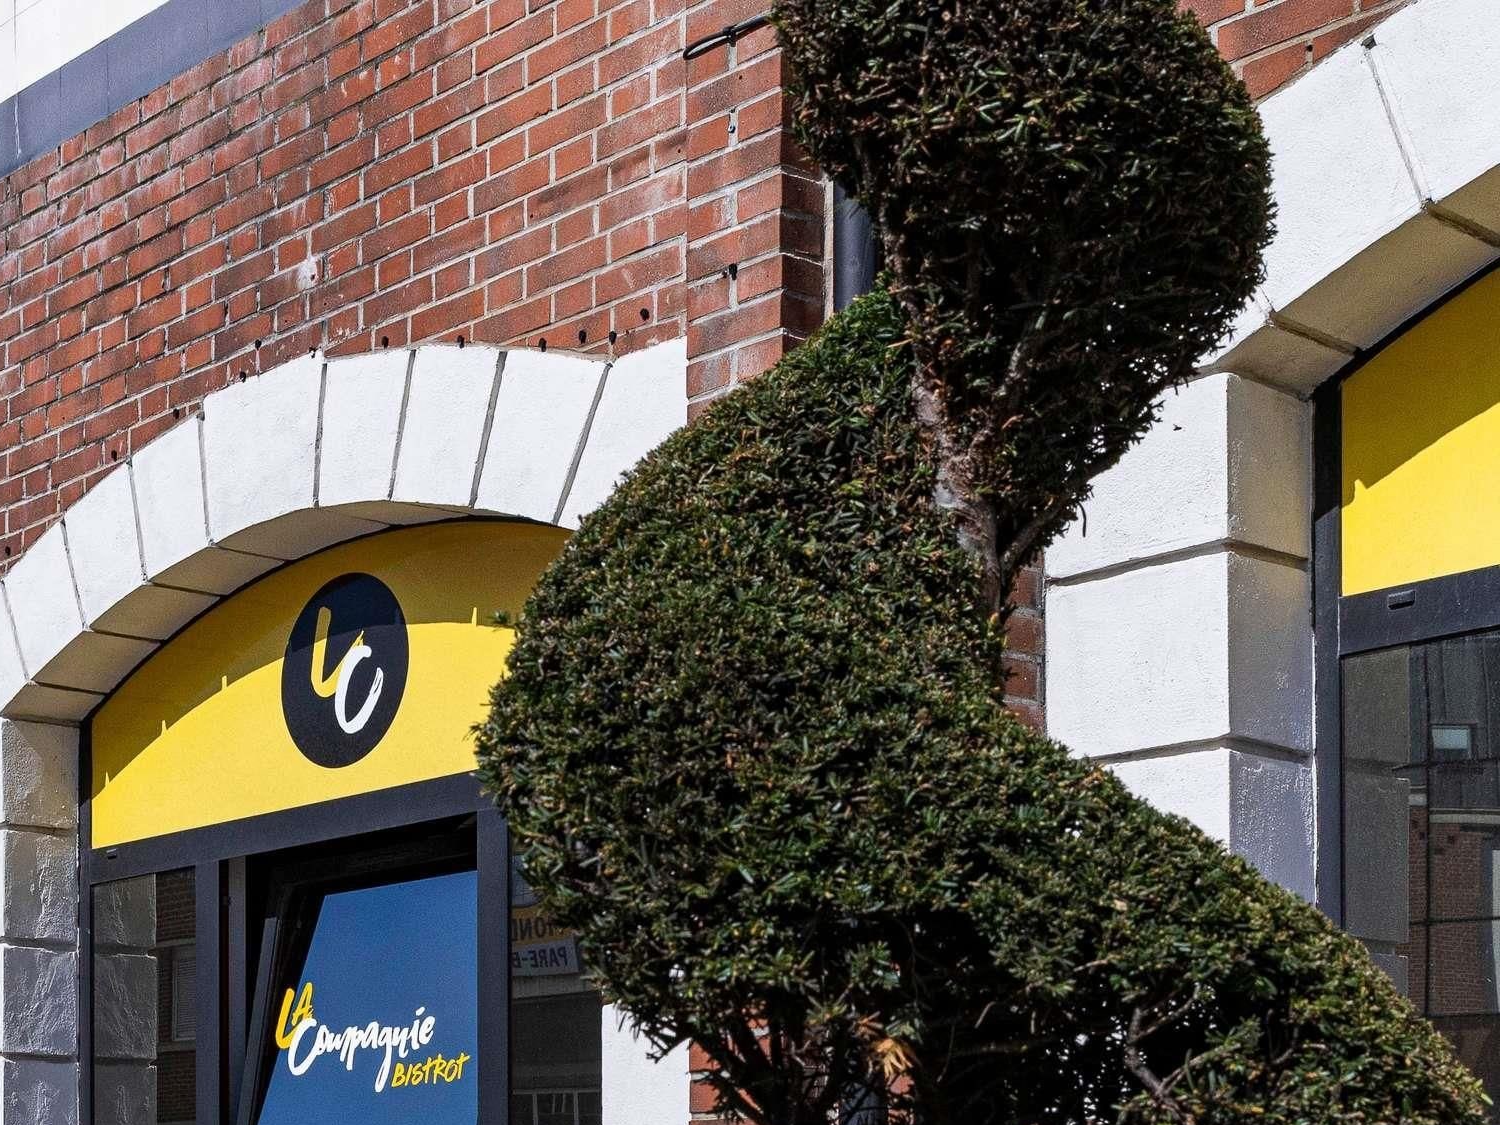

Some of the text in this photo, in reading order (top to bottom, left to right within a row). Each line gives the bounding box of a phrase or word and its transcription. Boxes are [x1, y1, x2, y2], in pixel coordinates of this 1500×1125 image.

[275, 982, 315, 1049] LA
[287, 1006, 436, 1093] Compagnie
[391, 1051, 470, 1088] BISTROT
